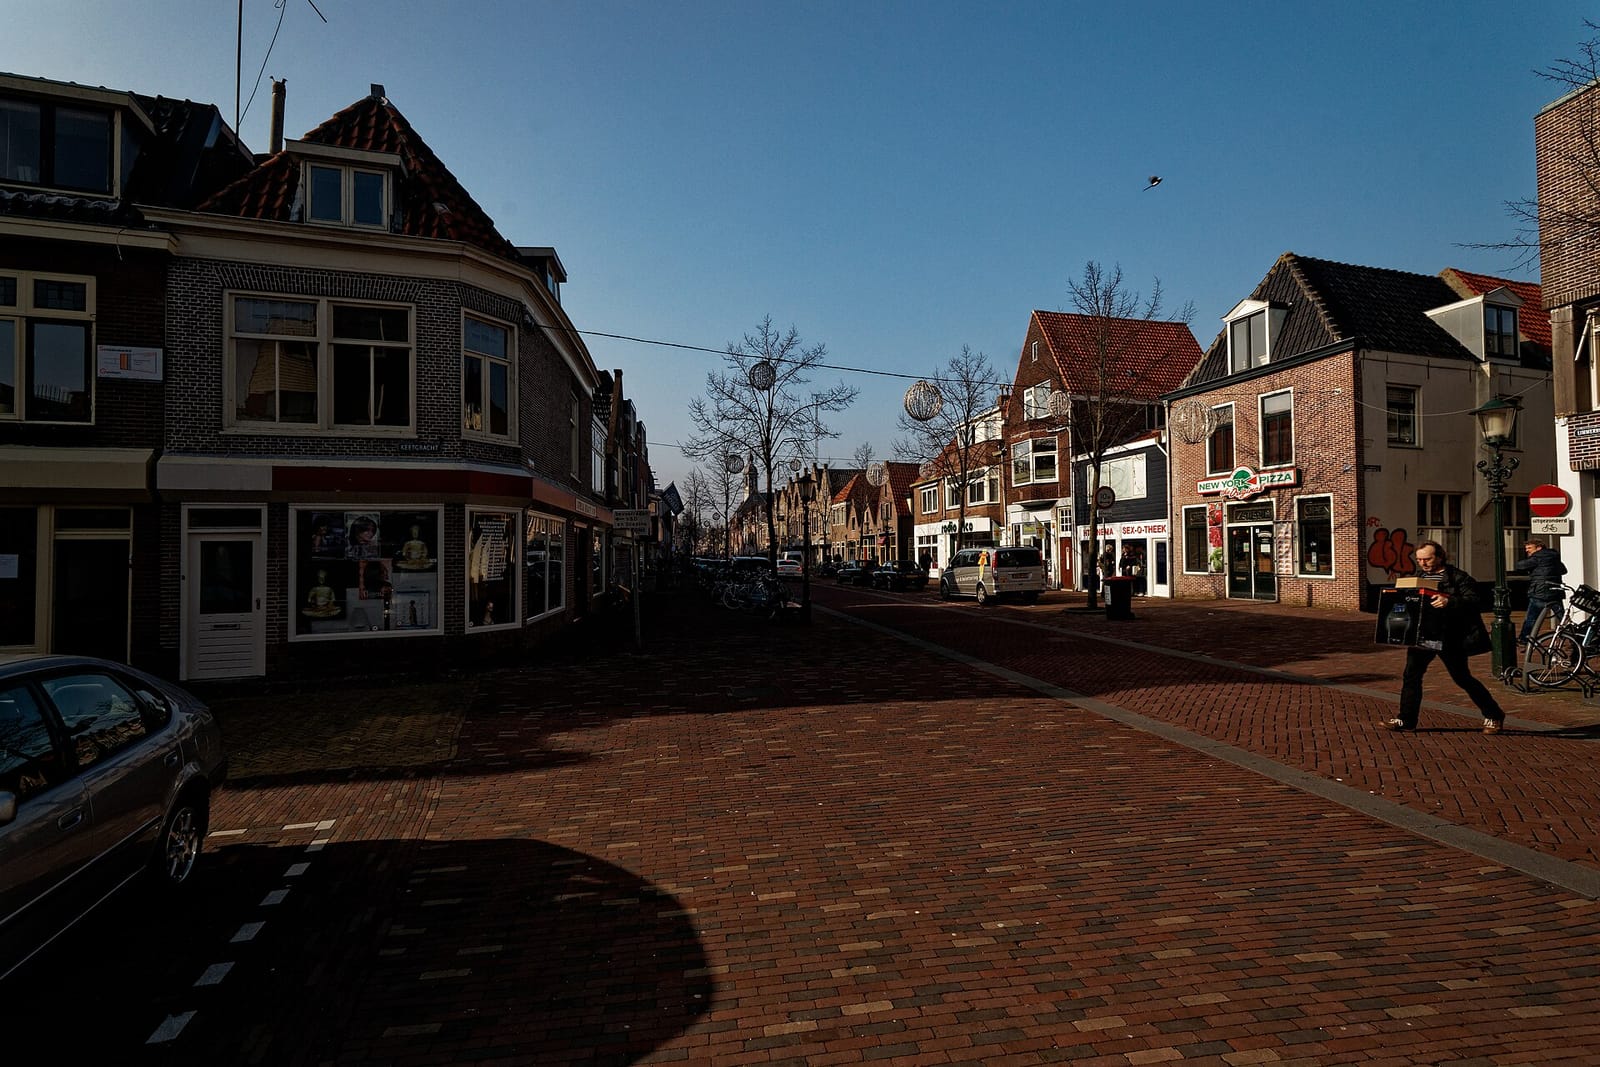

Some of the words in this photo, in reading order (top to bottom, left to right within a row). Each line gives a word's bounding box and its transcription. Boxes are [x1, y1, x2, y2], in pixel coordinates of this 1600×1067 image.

[1199, 481, 1220, 491] NEW
[1221, 478, 1248, 488] YORK
[1259, 473, 1293, 484] PIZZA
[1122, 525, 1166, 535] SEX-O-THEEK
